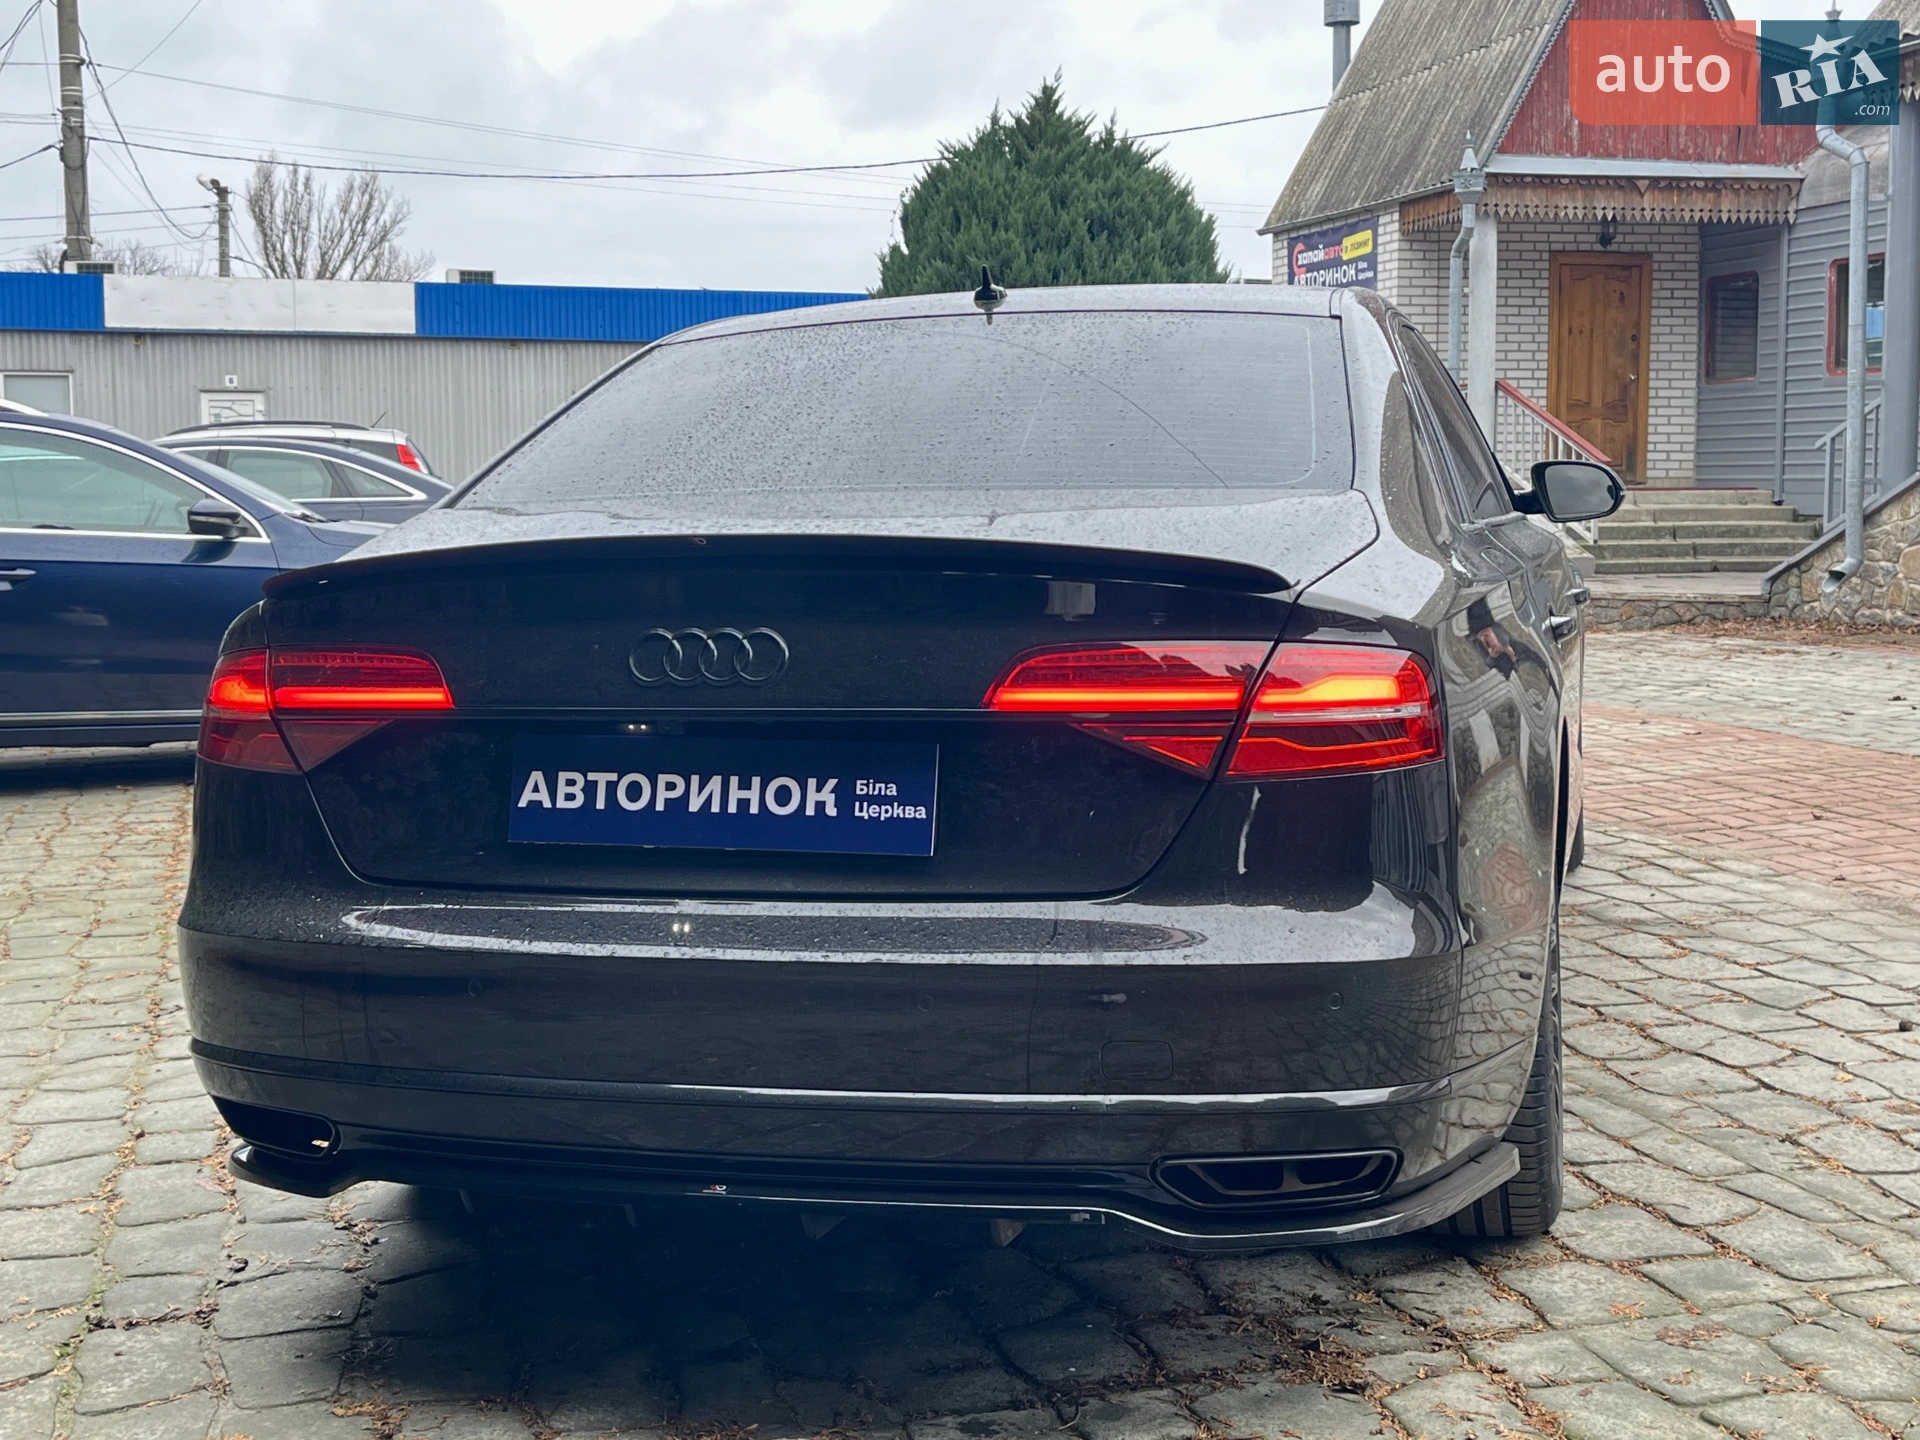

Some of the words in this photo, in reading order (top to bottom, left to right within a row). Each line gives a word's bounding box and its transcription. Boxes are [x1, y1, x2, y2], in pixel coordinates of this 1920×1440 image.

[1294, 263, 1356, 287] АВТОРИНОК
[517, 770, 838, 817] АВТОРИНОК
[855, 779, 897, 797] Біла
[854, 801, 927, 820] Церква
